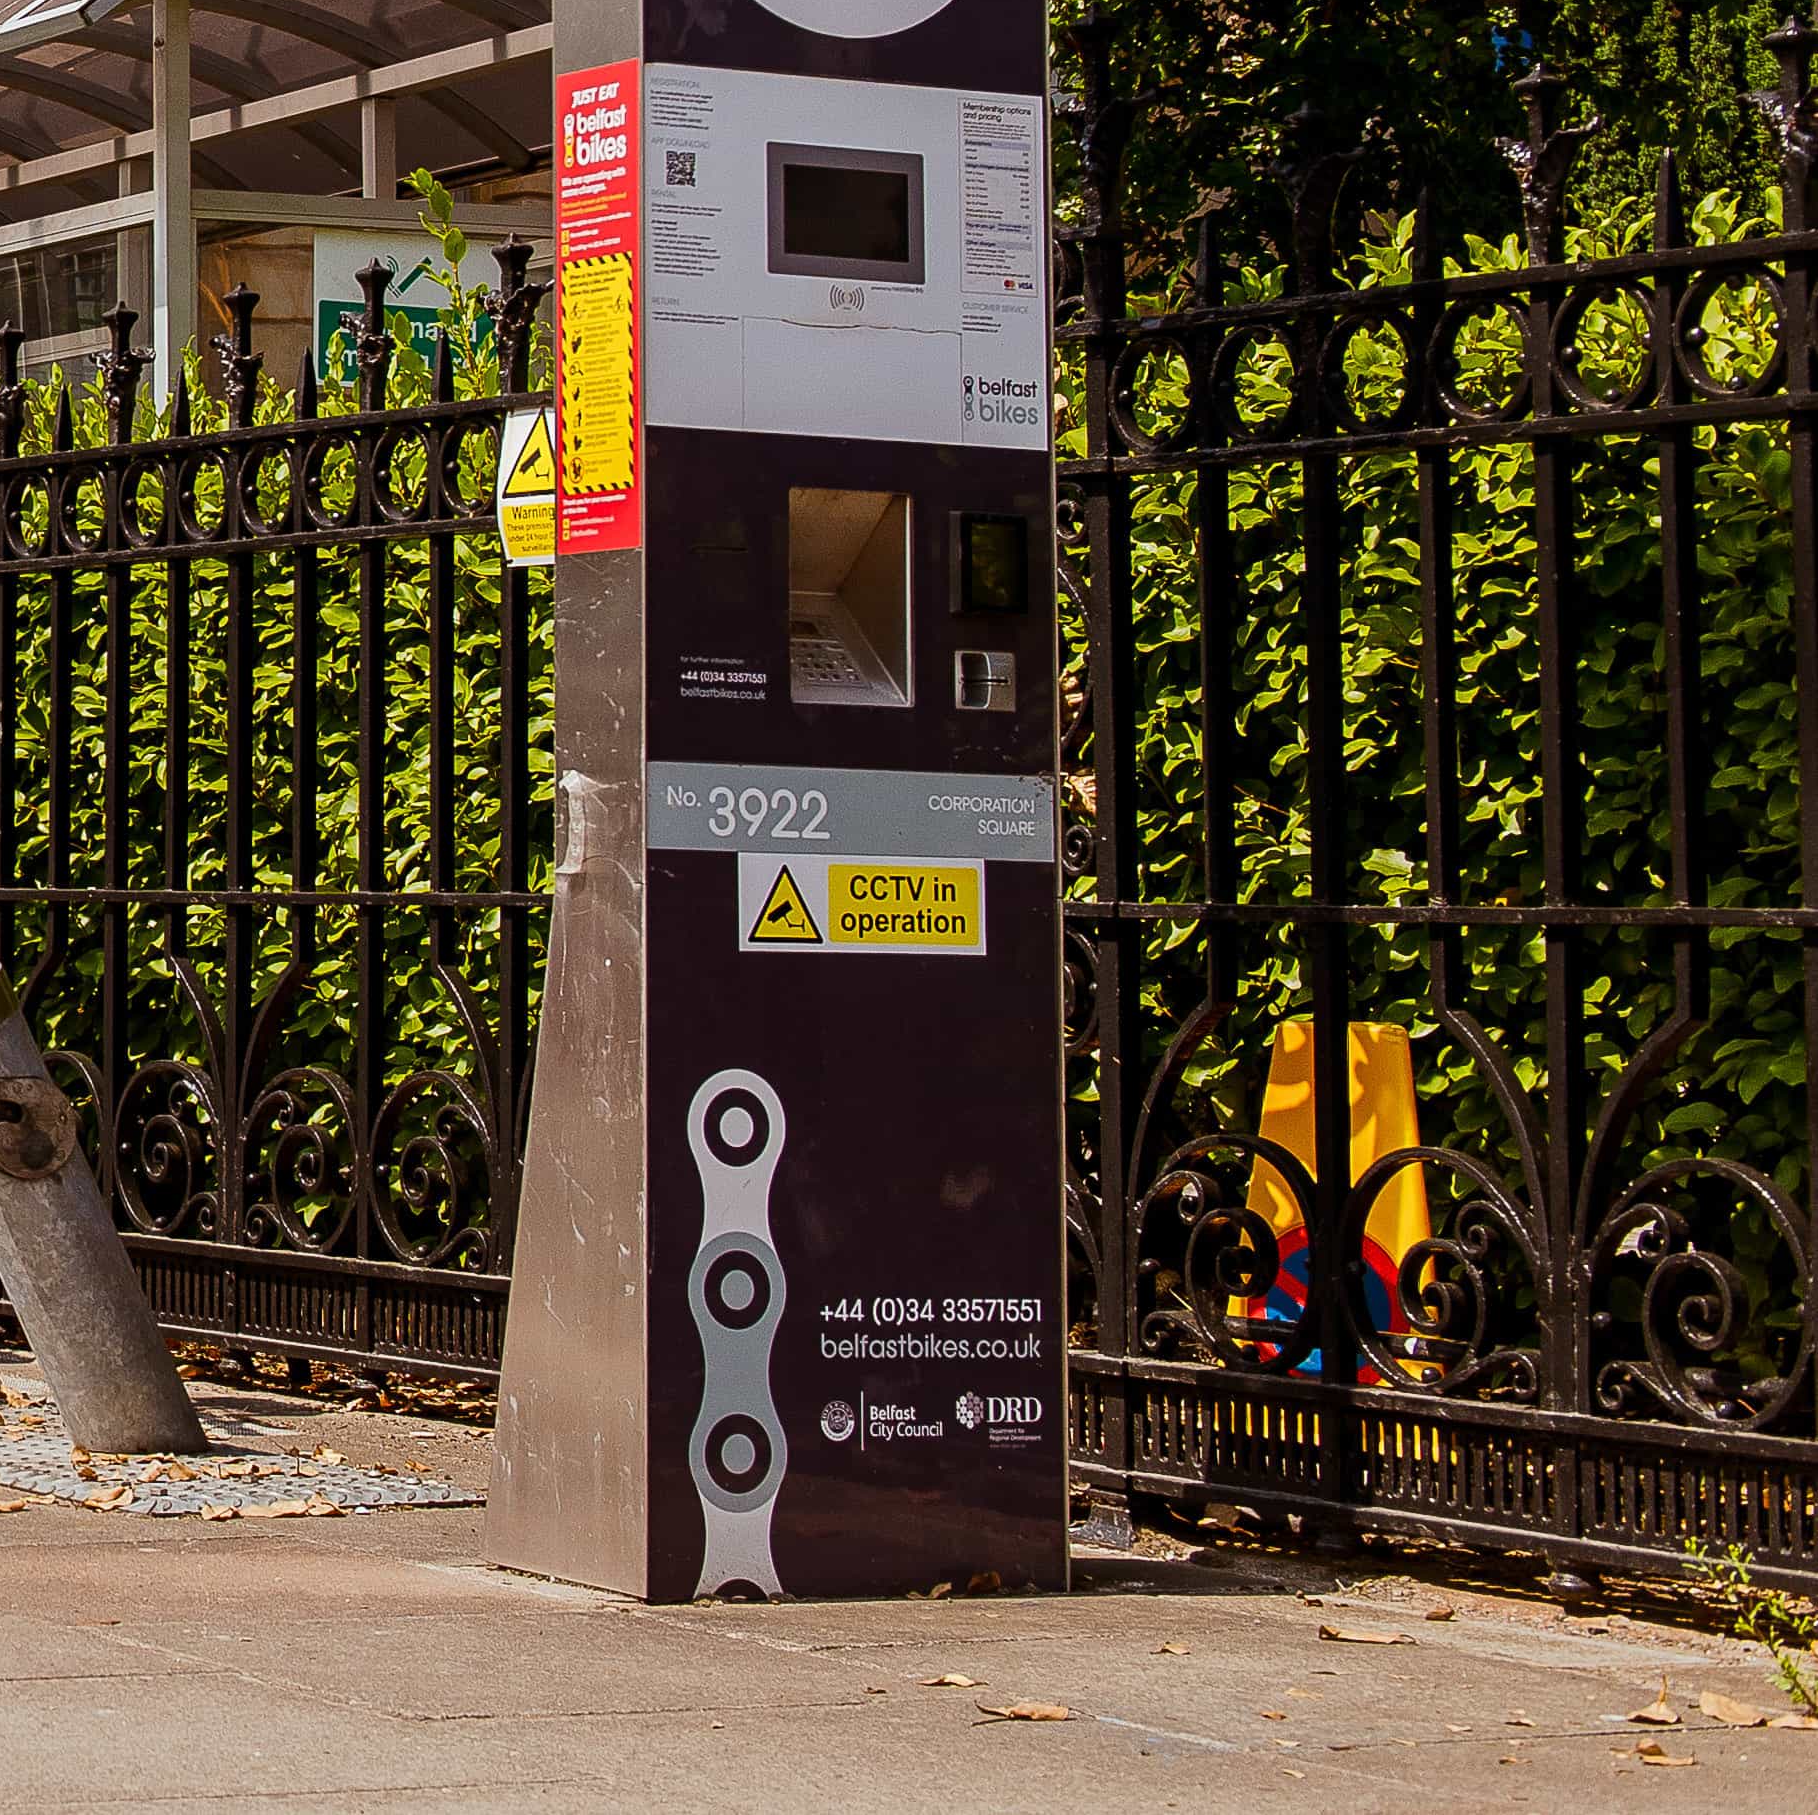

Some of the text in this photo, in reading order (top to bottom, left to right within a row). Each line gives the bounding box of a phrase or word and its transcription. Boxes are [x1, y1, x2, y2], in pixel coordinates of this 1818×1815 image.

[571, 82, 620, 109] JUST EAT
[576, 104, 627, 135] belfast
[978, 113, 1002, 123] pricing
[576, 133, 627, 166] bikes
[978, 376, 1038, 398] belfast
[979, 397, 1038, 425] bikes
[511, 505, 555, 520] Warning
[680, 670, 767, 684] +44 (0)34 33571551
[680, 686, 767, 700] belfastbikes.co.uk
[667, 785, 831, 841] No. 3922
[928, 794, 1035, 815] CORPORATION
[978, 818, 1036, 837] SQUARE
[849, 874, 957, 903] CCTV in
[840, 909, 966, 939] operation
[820, 1297, 1042, 1326] +44 (0)34 33571551
[821, 1333, 1041, 1359] belfastbikes.co.uk
[869, 1404, 916, 1421] Belfast
[986, 1396, 1042, 1423] DRD
[869, 1421, 894, 1441] City
[896, 1421, 943, 1438] Council
